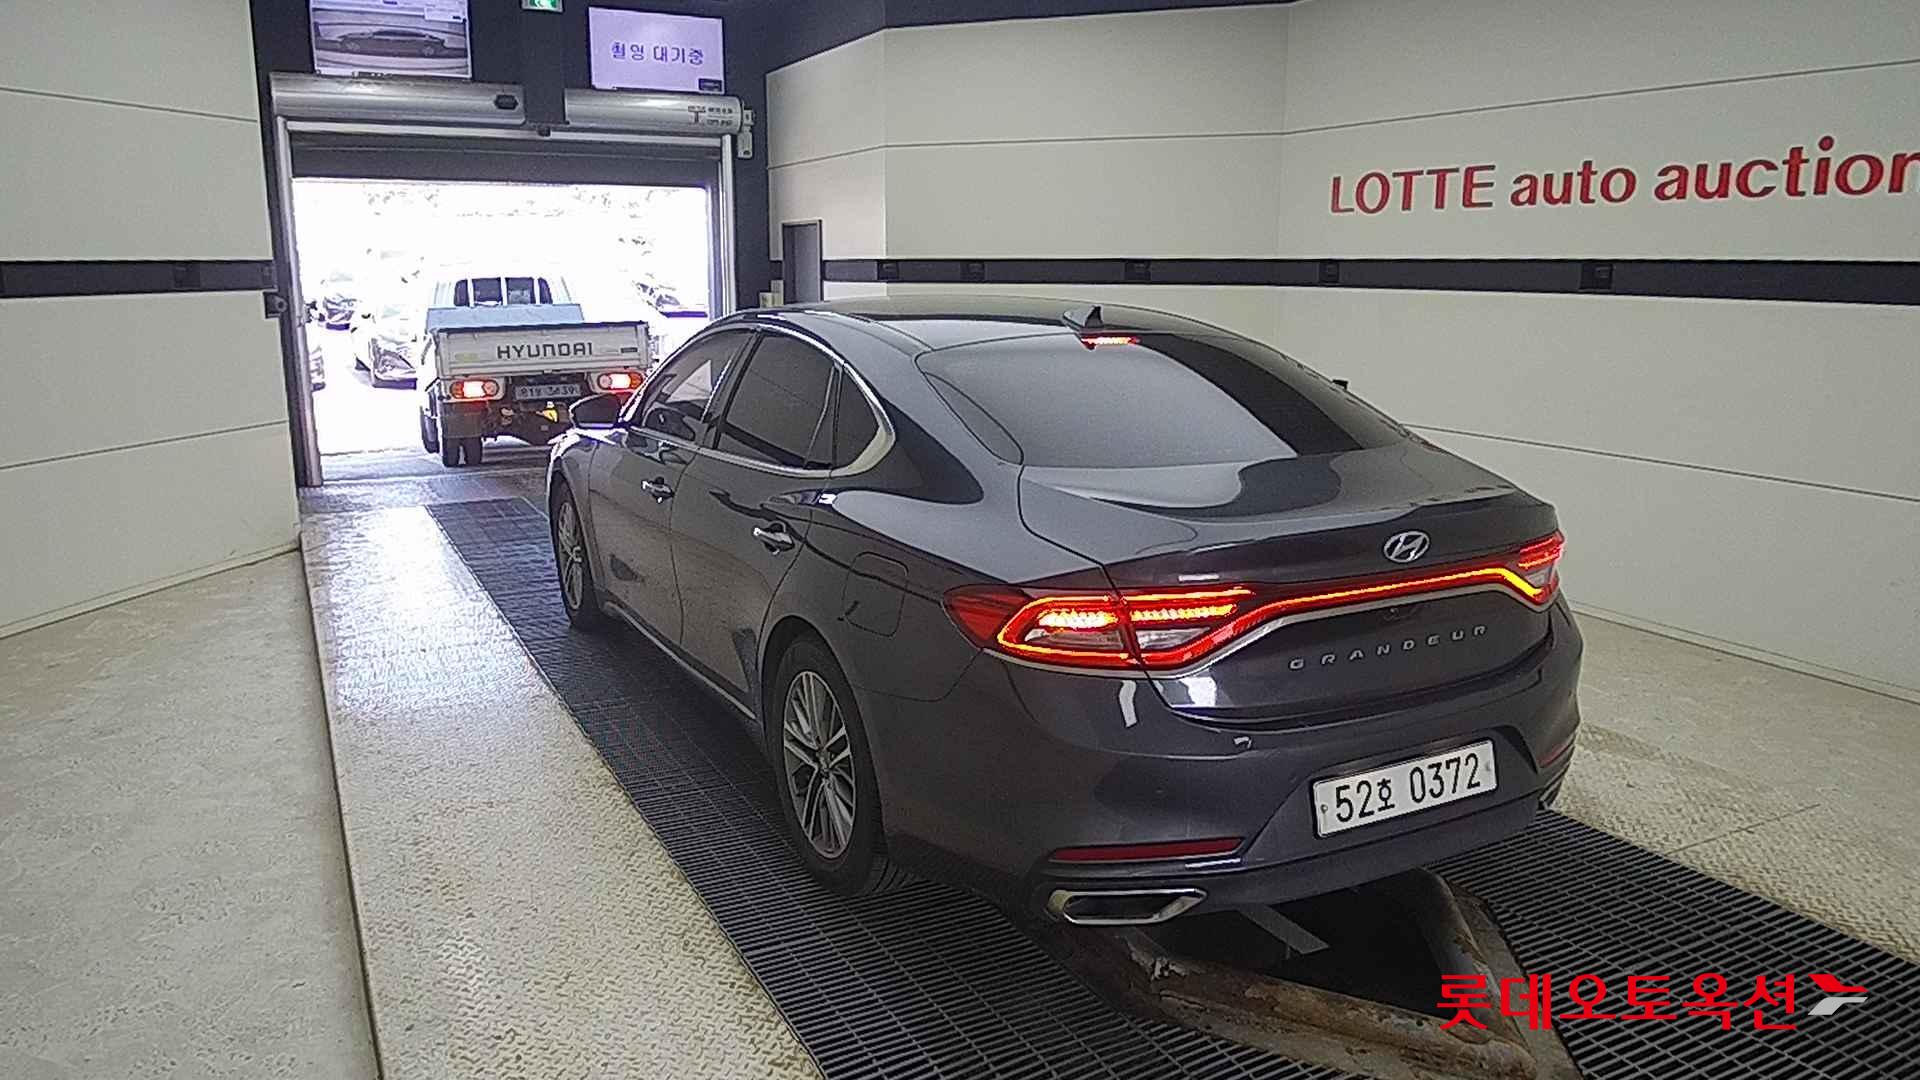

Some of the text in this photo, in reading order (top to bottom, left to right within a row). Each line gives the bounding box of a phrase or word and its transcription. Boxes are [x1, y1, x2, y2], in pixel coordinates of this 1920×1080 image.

[653, 45, 704, 66] 대기중
[1330, 164, 1497, 215] LOTTE
[1510, 159, 1637, 207] auto
[497, 342, 593, 359] HYUNDAI
[1289, 625, 1486, 670] GRANDEUR
[1335, 752, 1481, 823] 52호 0372
